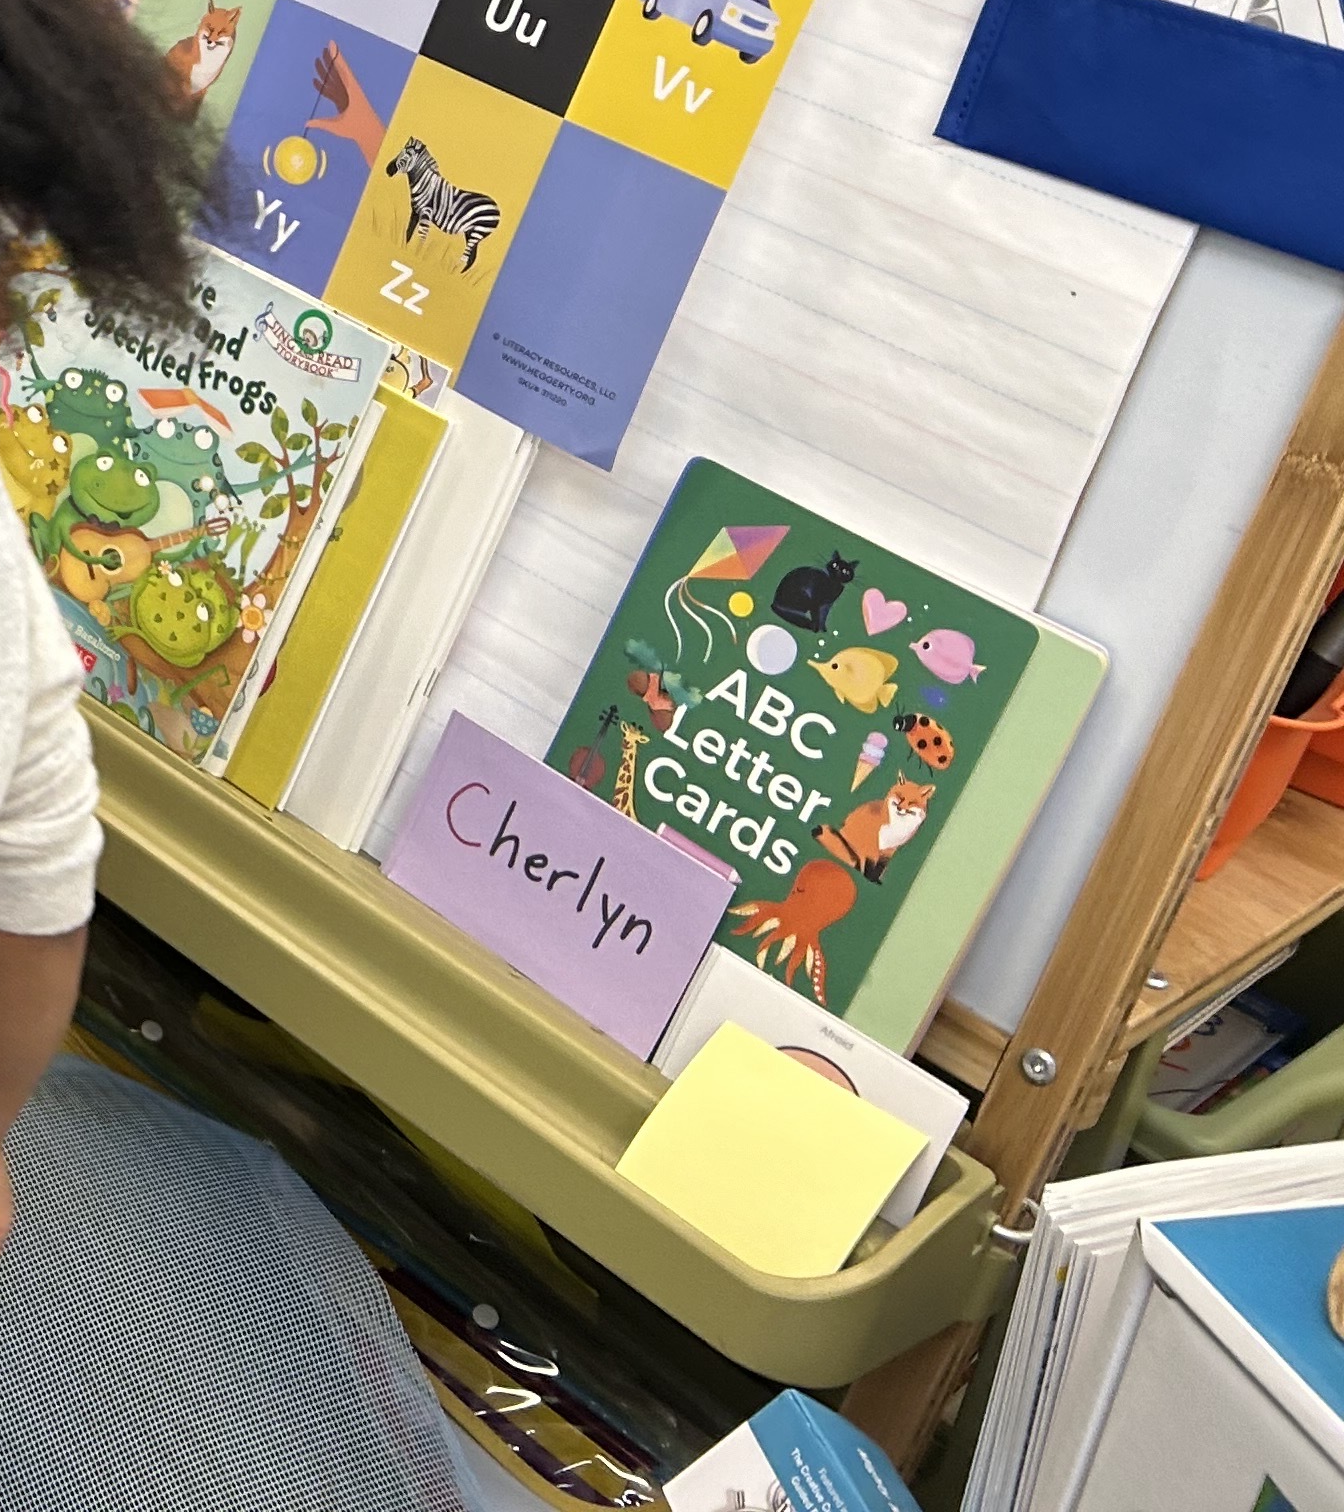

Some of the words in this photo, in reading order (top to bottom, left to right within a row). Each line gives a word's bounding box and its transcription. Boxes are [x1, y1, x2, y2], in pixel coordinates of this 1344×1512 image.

[652, 55, 713, 114] Vv
[251, 190, 300, 253] Yy
[379, 260, 430, 315] Zz
[502, 338, 543, 363] LITERACY
[198, 360, 278, 414] Frogs
[705, 667, 838, 759] ABC
[662, 704, 832, 824] Letter
[643, 756, 800, 876] Cards
[446, 781, 653, 954] Cherlyn
[819, 1025, 855, 1052] Afraid
